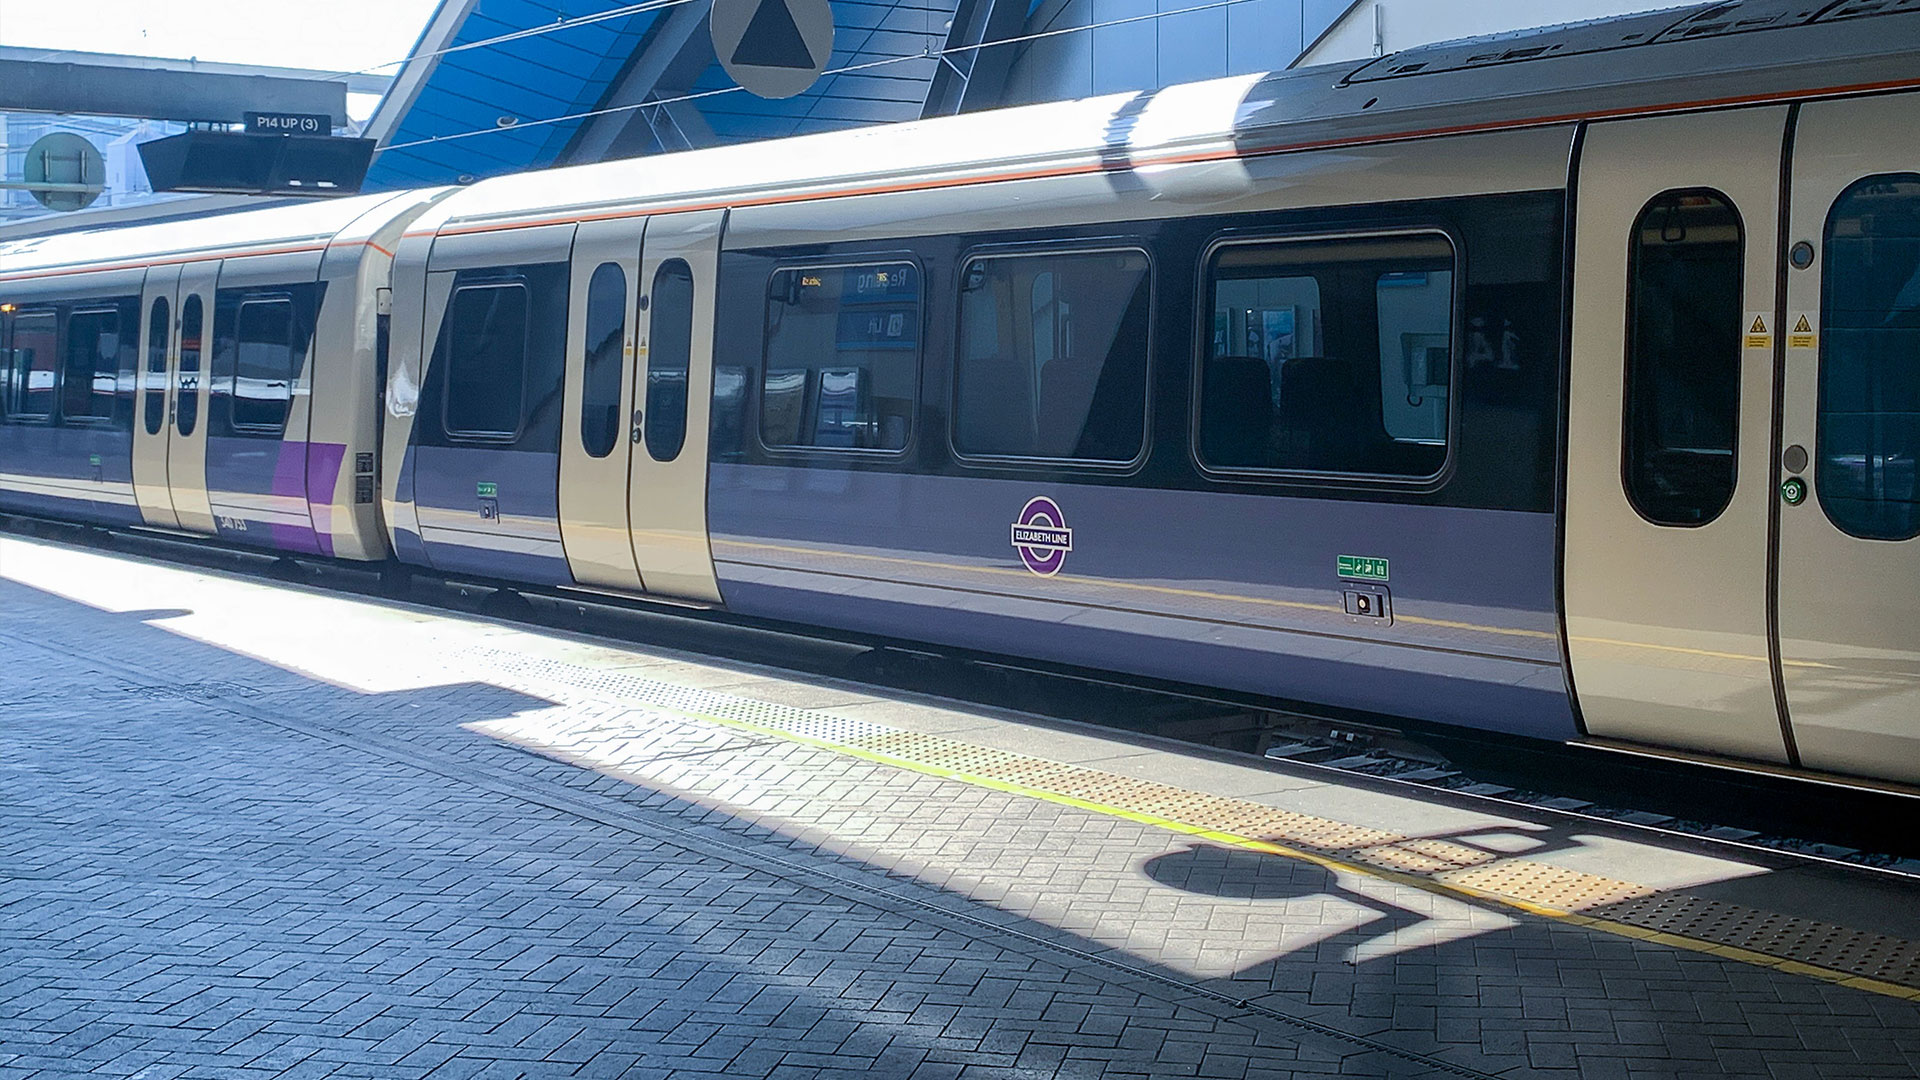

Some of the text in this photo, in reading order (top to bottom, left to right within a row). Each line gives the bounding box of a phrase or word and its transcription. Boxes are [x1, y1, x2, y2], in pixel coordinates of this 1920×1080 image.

[257, 116, 319, 131] P14 UP (3)
[1015, 530, 1068, 545] ELIZABETH LINE
